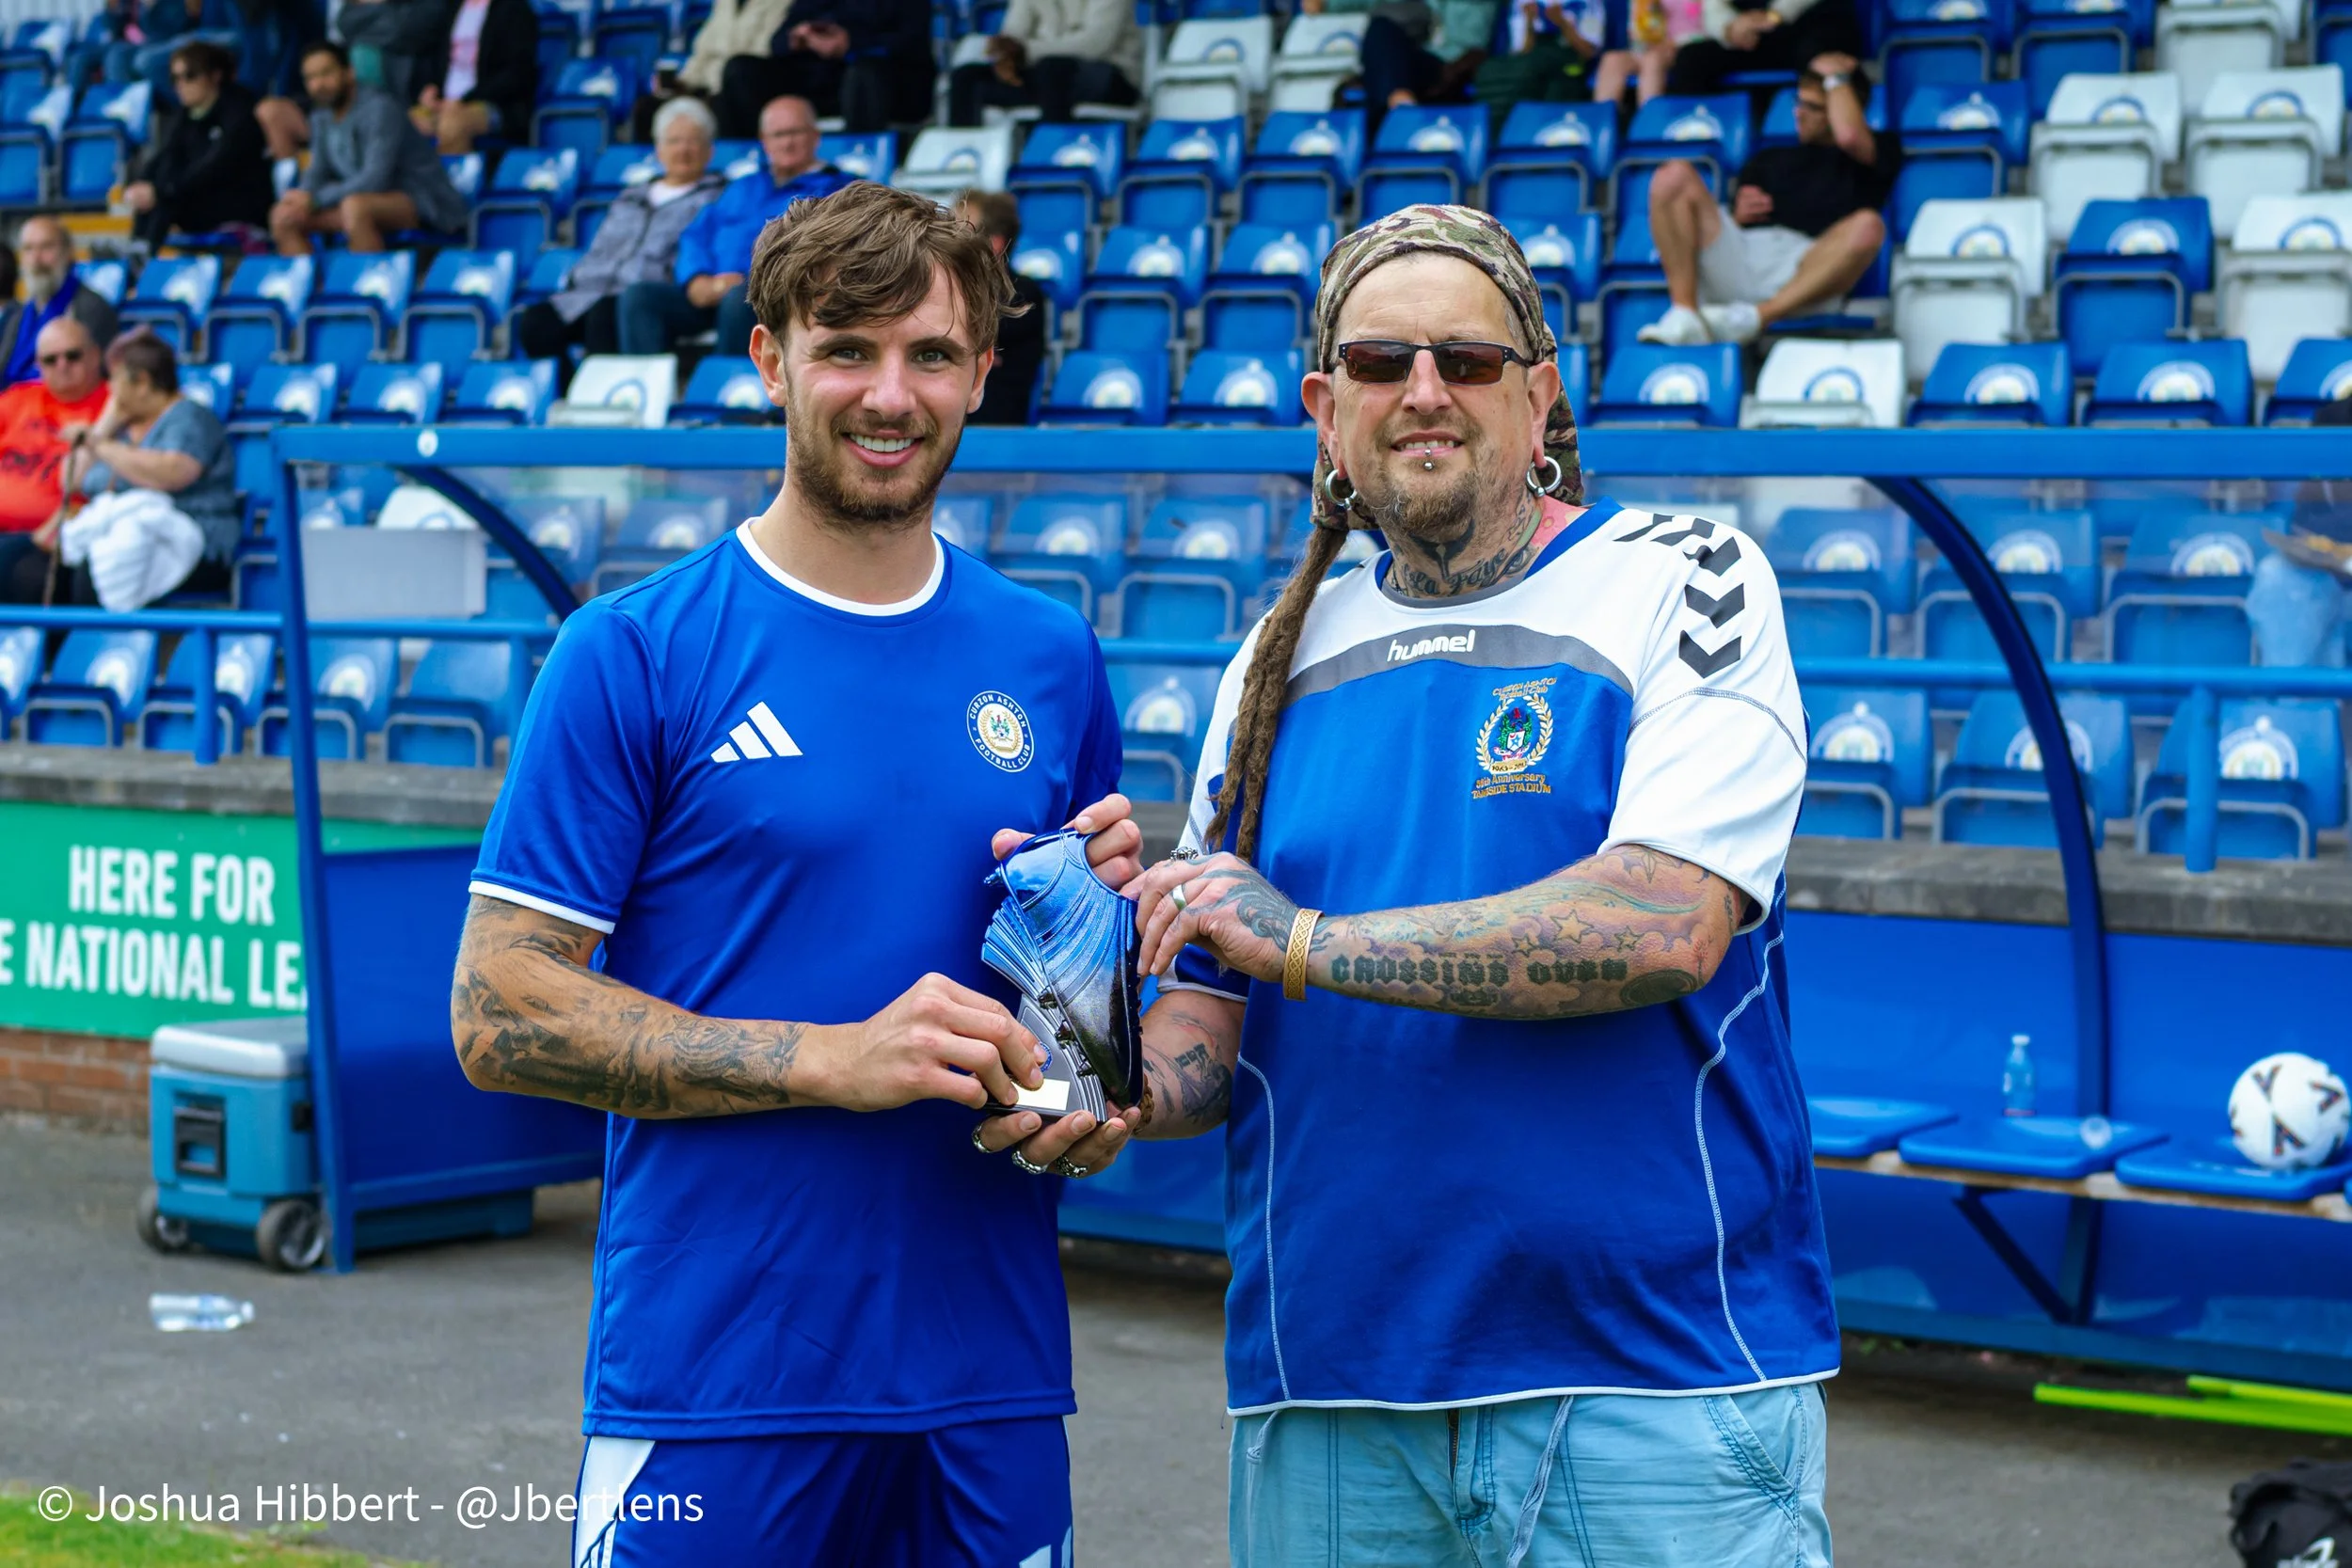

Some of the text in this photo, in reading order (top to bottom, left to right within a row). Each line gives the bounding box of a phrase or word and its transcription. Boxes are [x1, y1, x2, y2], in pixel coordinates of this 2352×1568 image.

[1386, 628, 1476, 662] hummel
[970, 694, 1026, 727] CURZON ASHTON
[976, 738, 1030, 768] FOOTBALL CLUB
[1492, 773, 1546, 784] Anniversary
[1509, 783, 1551, 793] STADIUM
[69, 845, 275, 927] HERE FOR
[25, 920, 234, 1006] NATIONAL
[247, 938, 308, 1010] LE
[1331, 954, 1628, 987] CROSSING OVER
